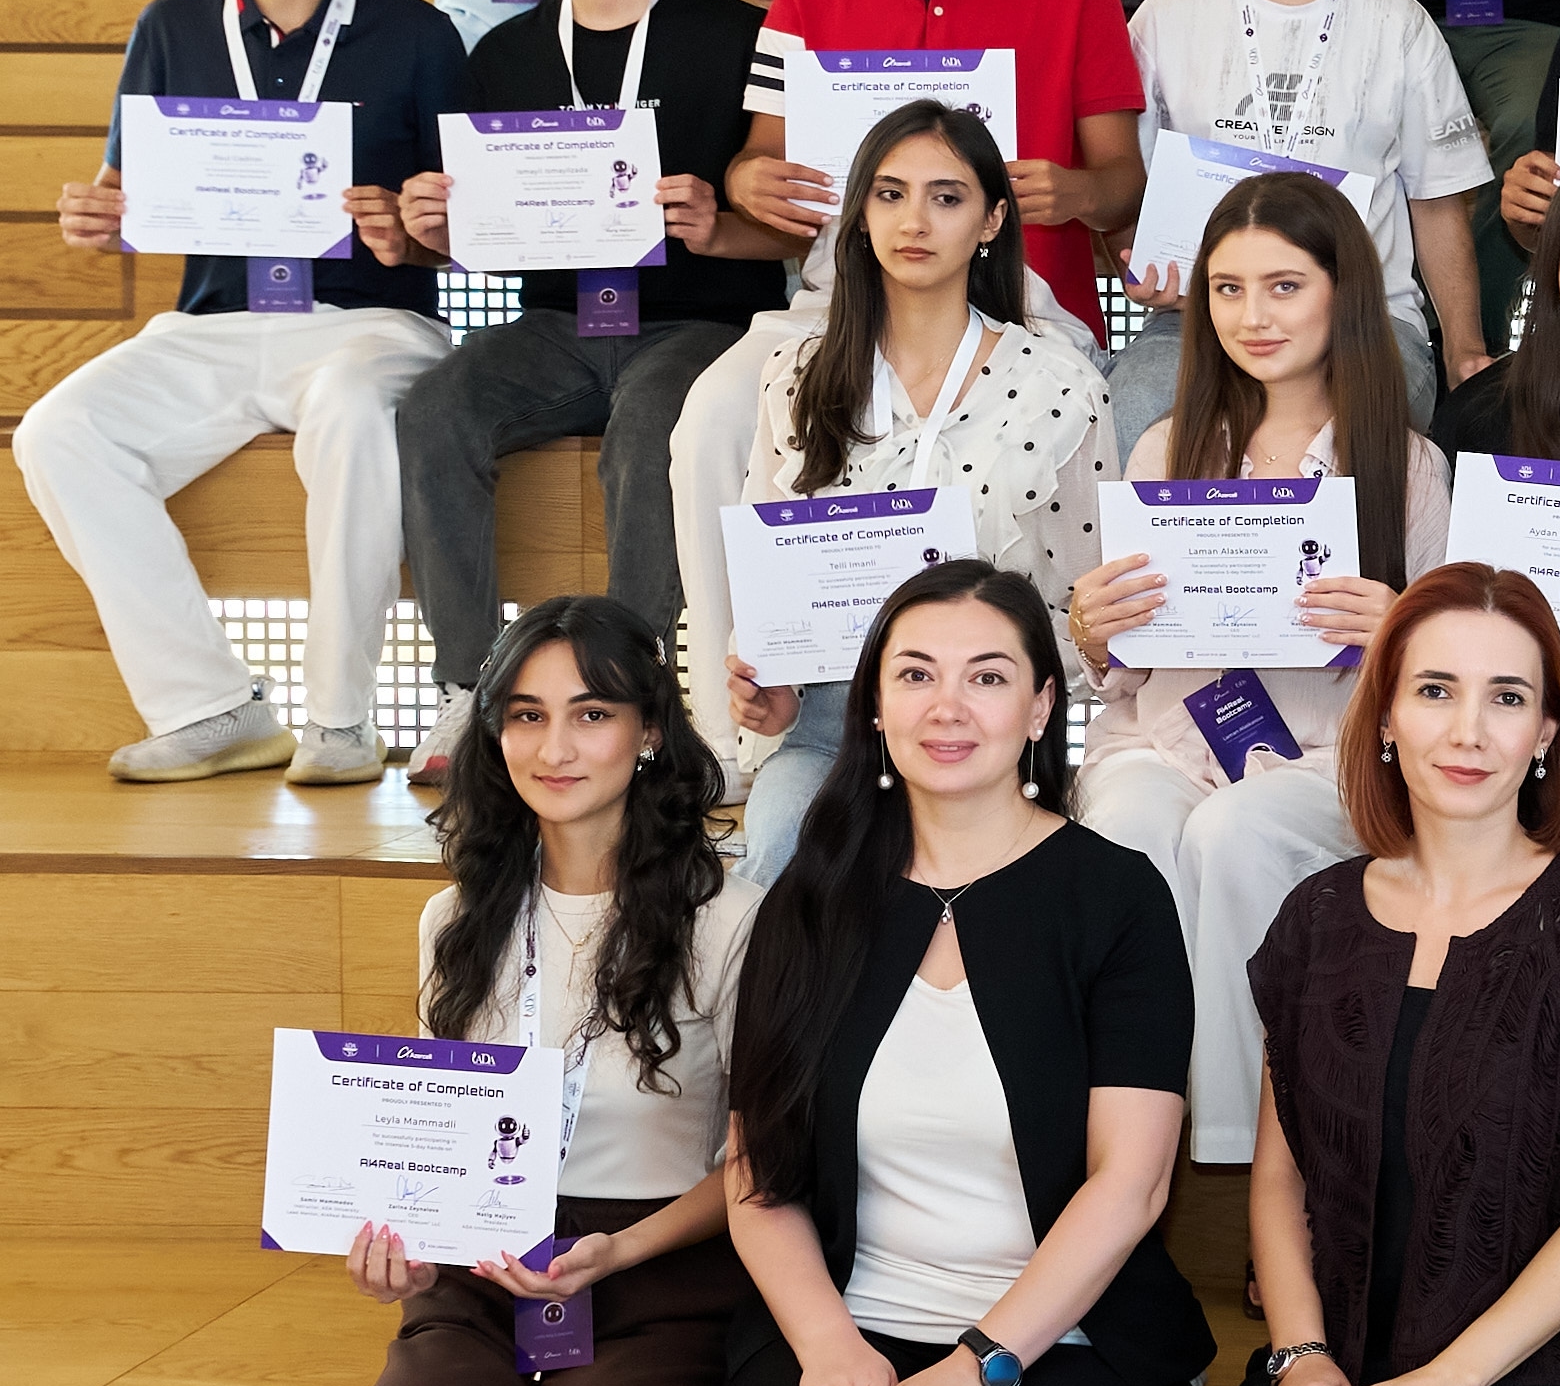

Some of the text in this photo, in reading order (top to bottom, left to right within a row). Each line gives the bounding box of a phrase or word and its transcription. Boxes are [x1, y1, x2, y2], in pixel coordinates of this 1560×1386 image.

[832, 82, 969, 91] Certificate of Completion
[170, 127, 228, 138] Certificate
[246, 131, 306, 140] Completion
[486, 140, 614, 152] Certificate of Completion
[551, 199, 595, 208] Bootcamp
[1151, 516, 1304, 527] Certificate of Completion
[776, 526, 924, 546] Certificate of Completion
[1529, 527, 1558, 538] Aydan
[1221, 547, 1268, 555] Alaskarova
[1184, 585, 1278, 595] AI4Real Bootcamp
[812, 599, 850, 609] AI4Real
[332, 1075, 504, 1099] Certificate of Completion
[375, 1115, 456, 1129] Leyla Mammadli
[360, 1159, 467, 1177] AI4Real Bootcamp
